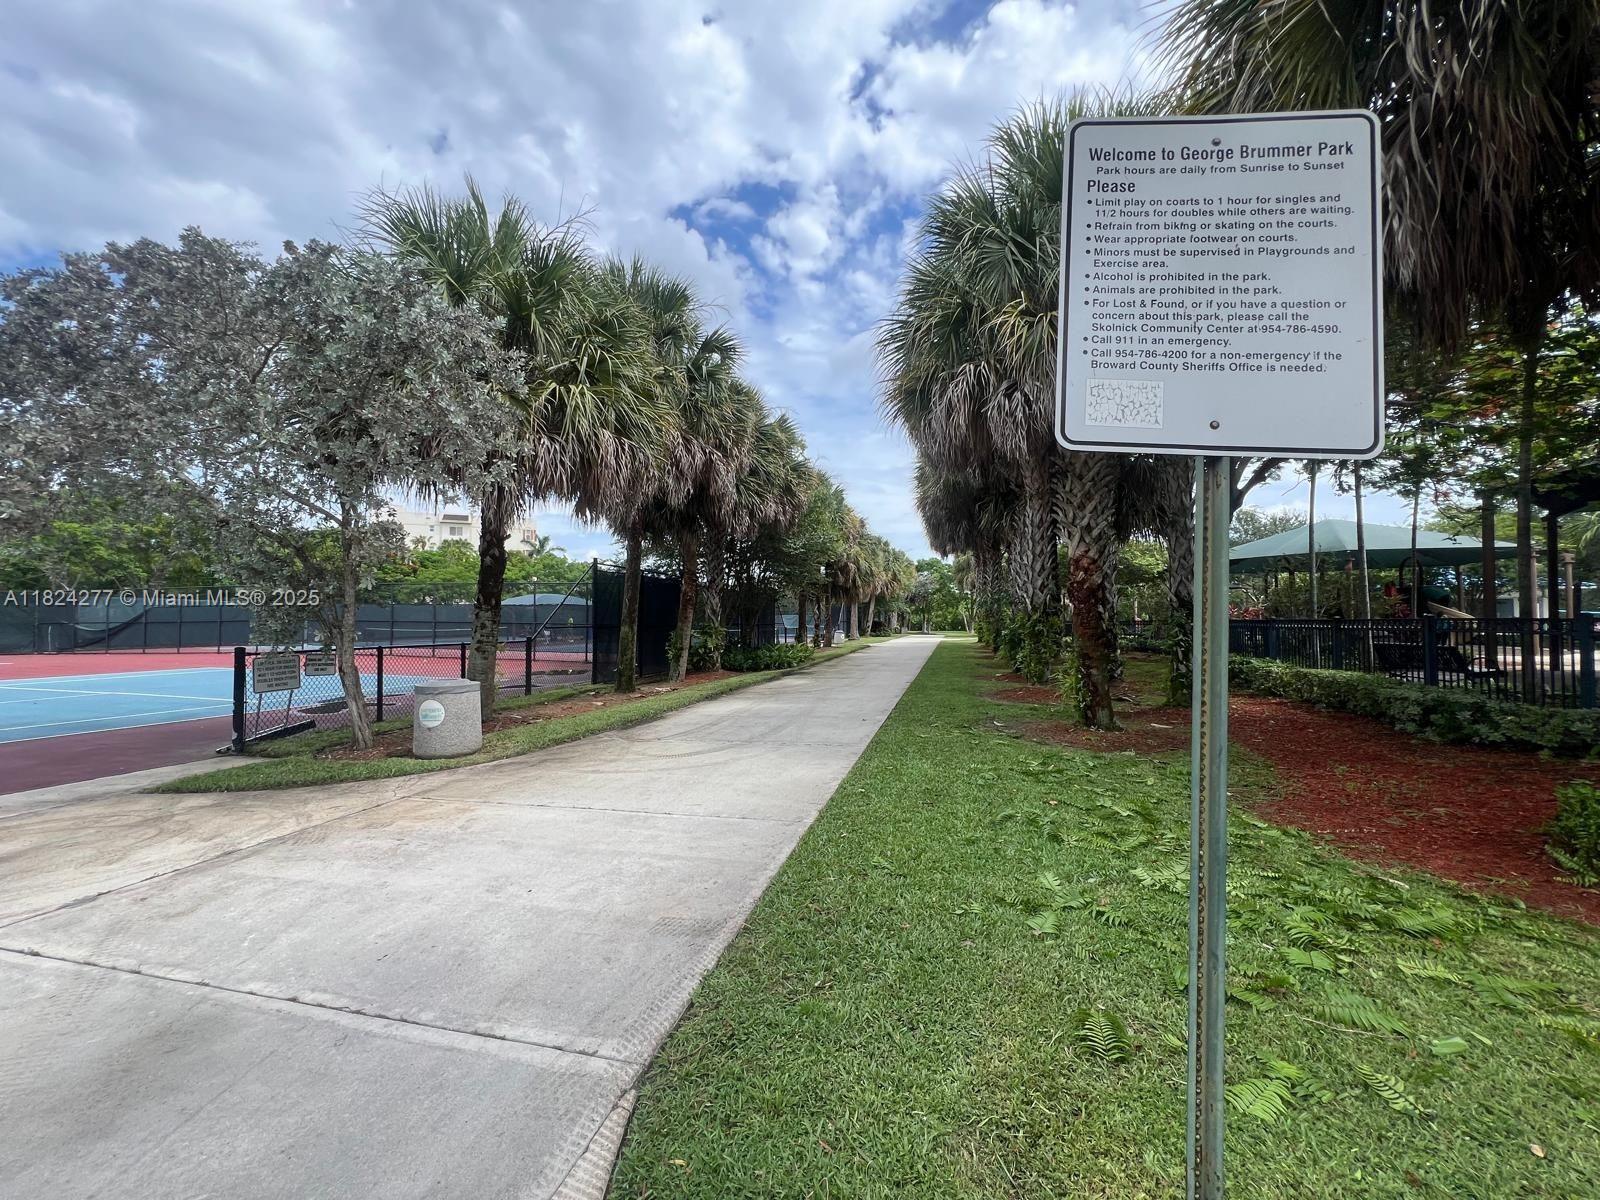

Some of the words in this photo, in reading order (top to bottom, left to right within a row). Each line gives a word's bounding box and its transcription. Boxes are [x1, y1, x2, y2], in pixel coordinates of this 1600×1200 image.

[1089, 147, 1156, 162] Welcome
[1162, 147, 1175, 161] to
[1181, 146, 1234, 163] George
[1240, 144, 1312, 159] Brummer
[1318, 141, 1354, 156] Park
[1096, 166, 1120, 175] Park
[1124, 166, 1156, 175] hours
[1180, 165, 1207, 175] daily
[1210, 165, 1236, 174] from
[1240, 163, 1285, 173] Sunrise
[1288, 162, 1299, 171] to
[1303, 161, 1344, 171] Sunset
[1087, 179, 1136, 193] Please
[1095, 198, 1121, 207] Limit
[1124, 198, 1146, 208] play
[1204, 198, 1214, 206] to
[1218, 197, 1222, 205] 1
[1227, 196, 1253, 205] hour
[1256, 195, 1271, 204] for
[1275, 194, 1316, 206] singles
[1319, 194, 1341, 203] and
[1119, 209, 1150, 217] hours
[1153, 209, 1168, 217] for
[1171, 208, 1214, 217] doubles
[1217, 207, 1246, 216] while
[1250, 206, 1285, 216] others
[1289, 207, 1306, 215] are
[1310, 205, 1355, 216] waiting.
[1094, 221, 1132, 230] Refrain
[1135, 221, 1160, 230] from
[1200, 222, 1211, 230] or
[1215, 220, 1255, 231] skating
[1258, 221, 1273, 229] on
[1276, 220, 1294, 228] the
[1297, 219, 1337, 228] courts.
[1094, 235, 1121, 243] Wear
[1124, 234, 1186, 245] appropriate
[1190, 234, 1238, 243] footwear
[1241, 234, 1255, 242] on
[1258, 233, 1298, 242] courts.
[1093, 248, 1130, 256] Minors
[1133, 248, 1160, 256] must
[1163, 247, 1177, 256] be
[1180, 246, 1240, 258] supervised
[1244, 247, 1254, 256] in
[1258, 246, 1330, 258] Playgrounds
[1333, 246, 1355, 255] and
[1093, 259, 1139, 268] Exercise
[1142, 260, 1169, 268] area.
[1093, 272, 1133, 281] Alcohol
[1136, 272, 1146, 281] is
[1149, 272, 1205, 283] prohibited
[1208, 272, 1218, 281] in
[1221, 272, 1239, 281] the
[1242, 272, 1271, 283] park.
[1092, 285, 1136, 294] Animals
[1138, 287, 1156, 295] are
[1159, 285, 1215, 296] prohibited
[1219, 286, 1229, 294] in
[1232, 286, 1250, 294] the
[1253, 286, 1282, 296] park.
[1092, 298, 1110, 308] For
[1113, 298, 1136, 308] Lost
[1139, 299, 1147, 308] &
[1151, 299, 1188, 310] Found,
[1191, 301, 1203, 309] or
[1206, 299, 1214, 308] if
[1216, 301, 1236, 310] you
[1240, 299, 1267, 309] have
[1270, 301, 1277, 309] a
[1281, 299, 1331, 310] question
[1334, 301, 1347, 309] or
[1092, 312, 1135, 320] concern
[1138, 311, 1169, 320] about
[1172, 311, 1192, 321] this
[1196, 312, 1224, 322] park,
[1227, 312, 1264, 323] please
[1267, 312, 1288, 321] call
[1291, 312, 1309, 321] the
[1091, 323, 1137, 332] Skolnick
[1141, 324, 1203, 335] Community
[1206, 324, 1244, 334] Center
[1247, 325, 1259, 333] at
[1261, 325, 1342, 334] 954-786-4590.
[1091, 335, 1112, 344] Call
[1115, 336, 1133, 344] 911
[1138, 336, 1148, 345] in
[1151, 337, 1164, 345] an
[1168, 337, 1232, 348] emergency.
[1091, 348, 1112, 357] Call
[1115, 349, 1188, 359] 954-786-4200
[1191, 350, 1207, 359] for
[1220, 351, 1309, 362] non-emergency
[1313, 351, 1321, 360] if
[1324, 351, 1343, 360] the
[1091, 360, 1136, 370] Broward
[1139, 361, 1179, 373] County
[1182, 362, 1225, 371] Sheriffs
[1229, 362, 1263, 371] Office
[1266, 363, 1276, 372] is
[1280, 363, 1327, 373] needed.
